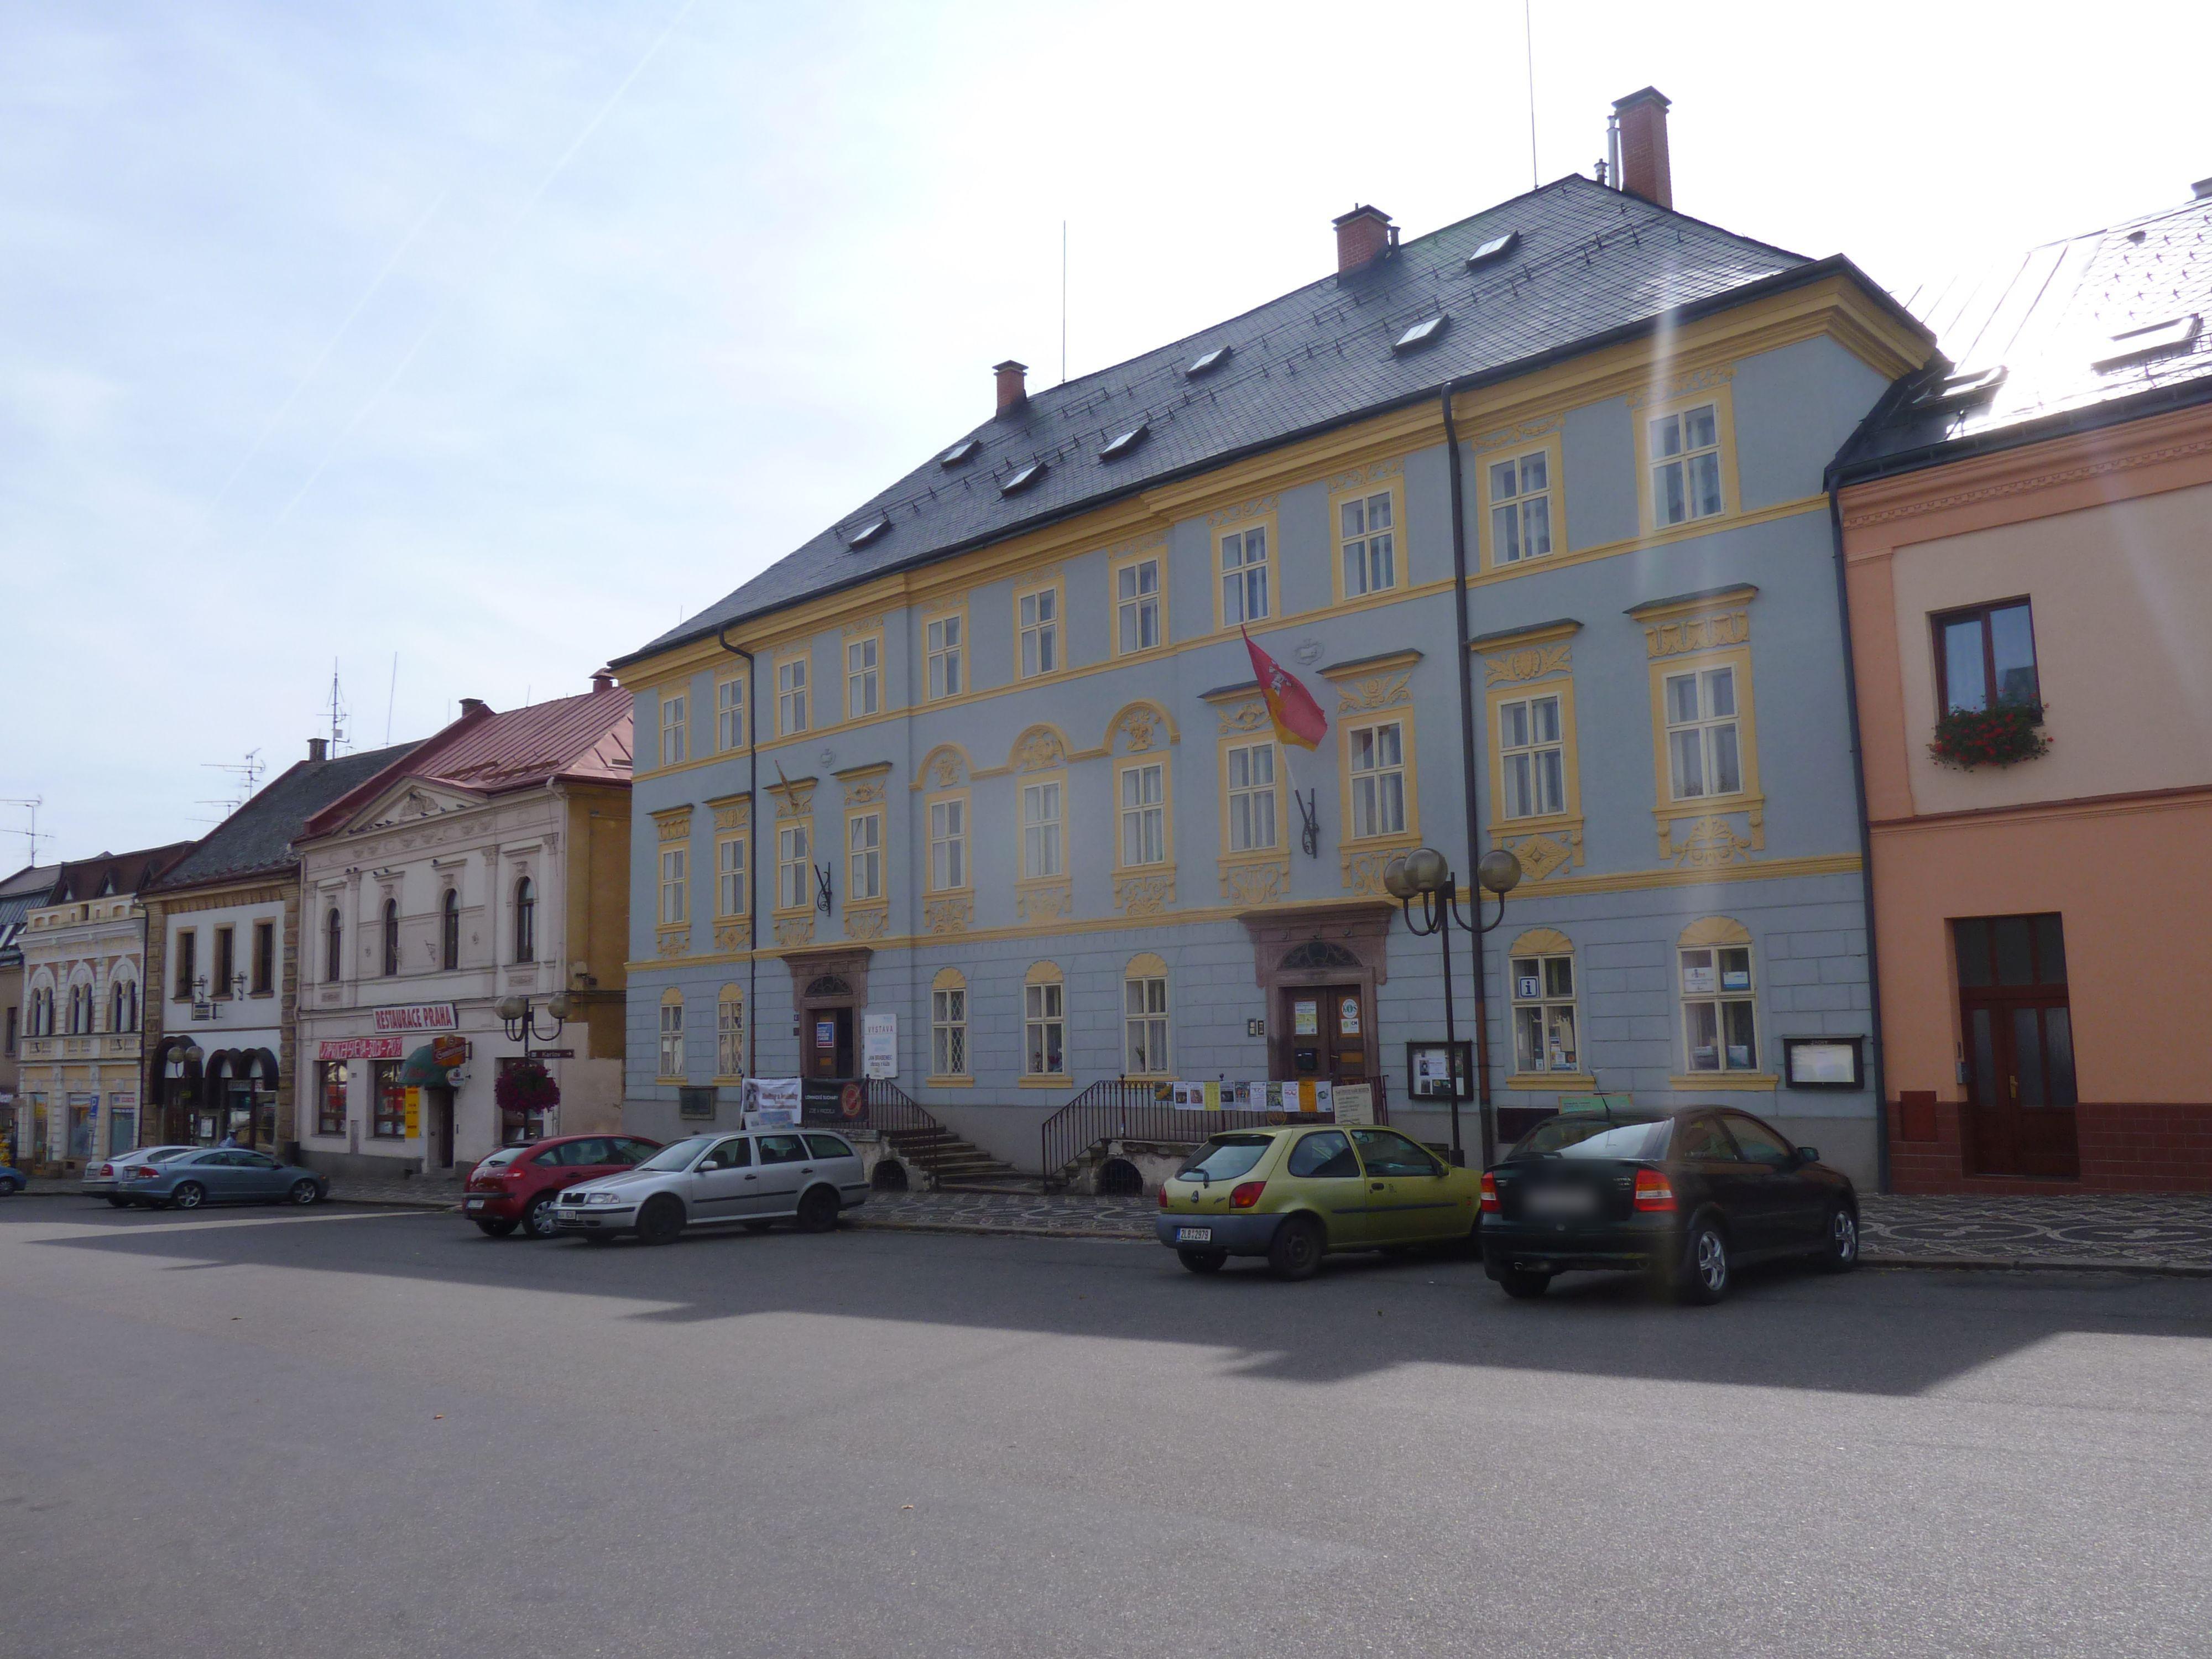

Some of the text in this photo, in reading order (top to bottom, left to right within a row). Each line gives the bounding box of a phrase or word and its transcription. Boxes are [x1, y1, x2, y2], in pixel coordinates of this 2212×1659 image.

[375, 1006, 452, 1029] RESTAURACE PRAHA
[91, 1097, 97, 1109] P
[1181, 1229, 1208, 1239] 2L8 2979
